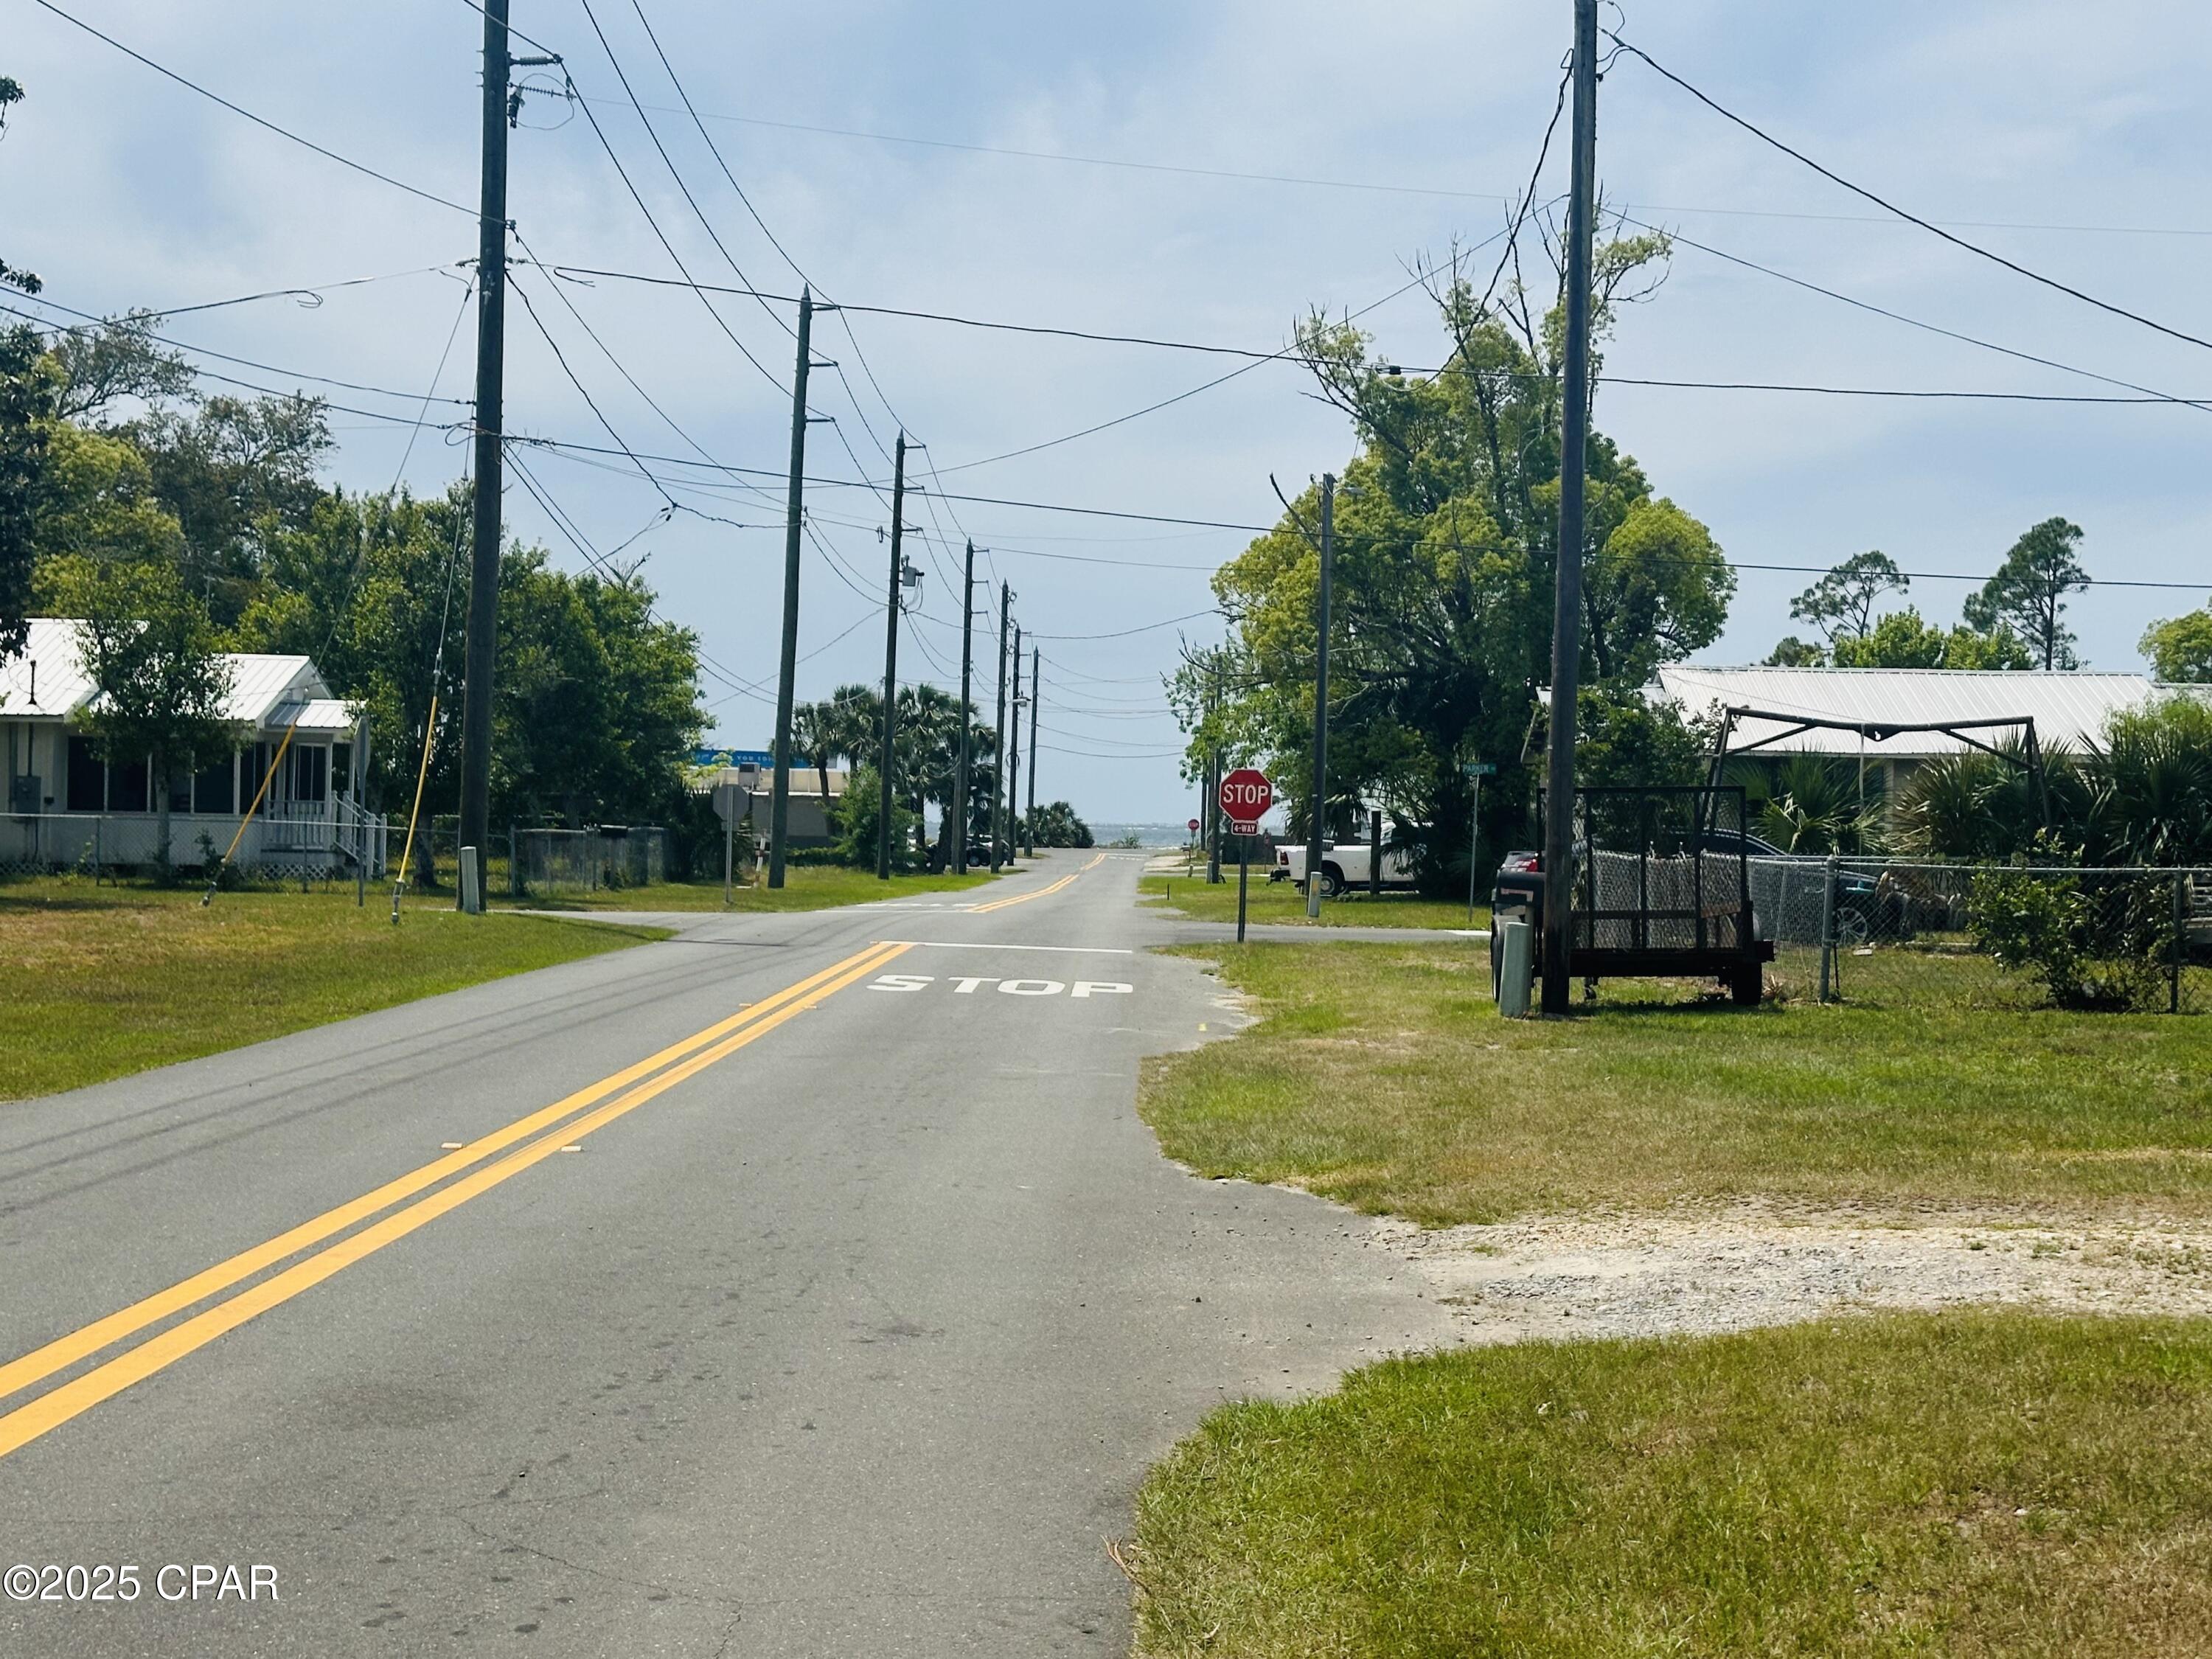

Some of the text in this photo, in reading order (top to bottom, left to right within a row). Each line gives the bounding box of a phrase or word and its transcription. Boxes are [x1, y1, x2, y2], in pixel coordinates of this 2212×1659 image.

[1222, 784, 1269, 804] STOP
[1234, 824, 1256, 832] 4-WAY
[866, 974, 1133, 998] STOP
